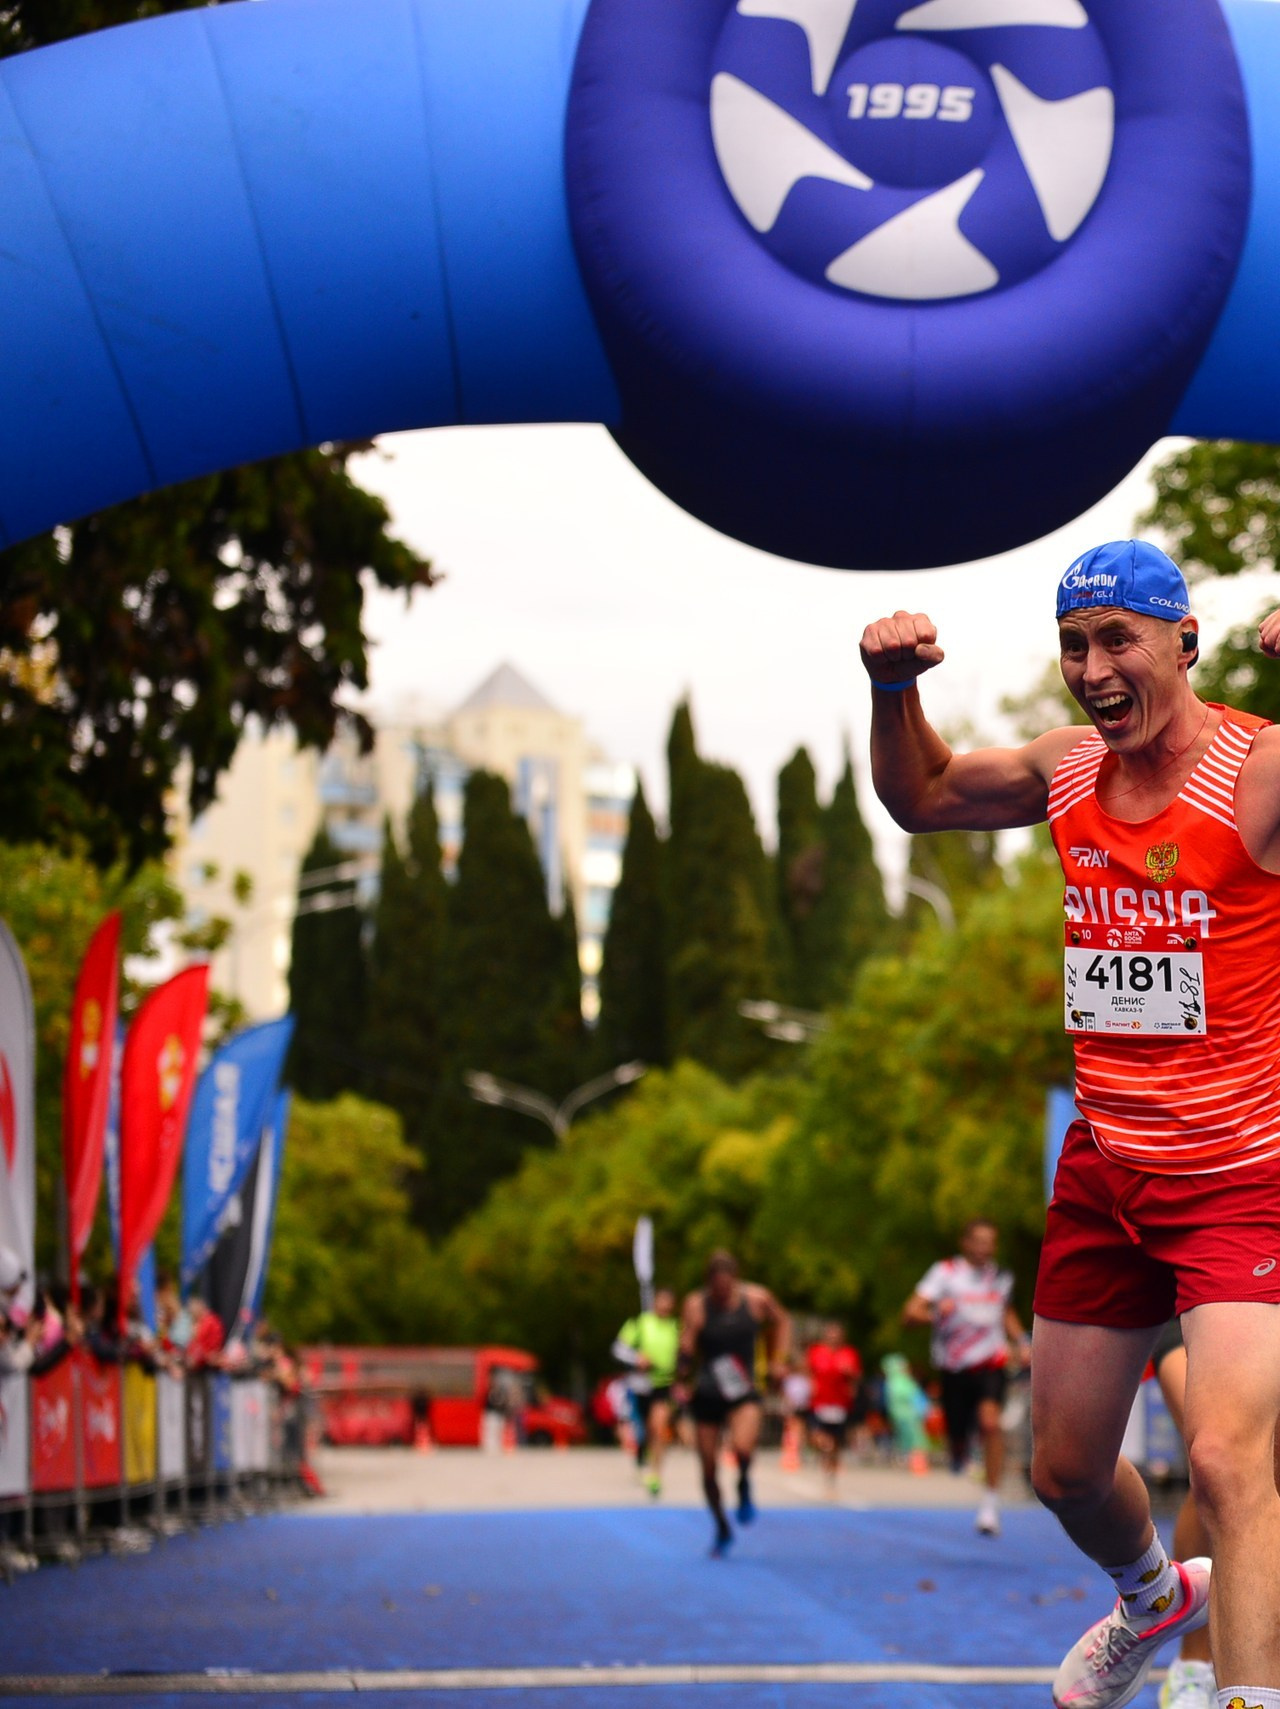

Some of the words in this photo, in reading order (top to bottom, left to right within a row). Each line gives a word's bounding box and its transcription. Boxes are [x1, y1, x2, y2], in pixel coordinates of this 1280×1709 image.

[846, 83, 976, 122] 1995
[1069, 847, 1110, 868] RAY
[1064, 886, 1217, 938] RUSSIA
[1081, 929, 1092, 940] 10
[1085, 954, 1173, 992] 4181
[1111, 996, 1146, 1006] ДЕНИС
